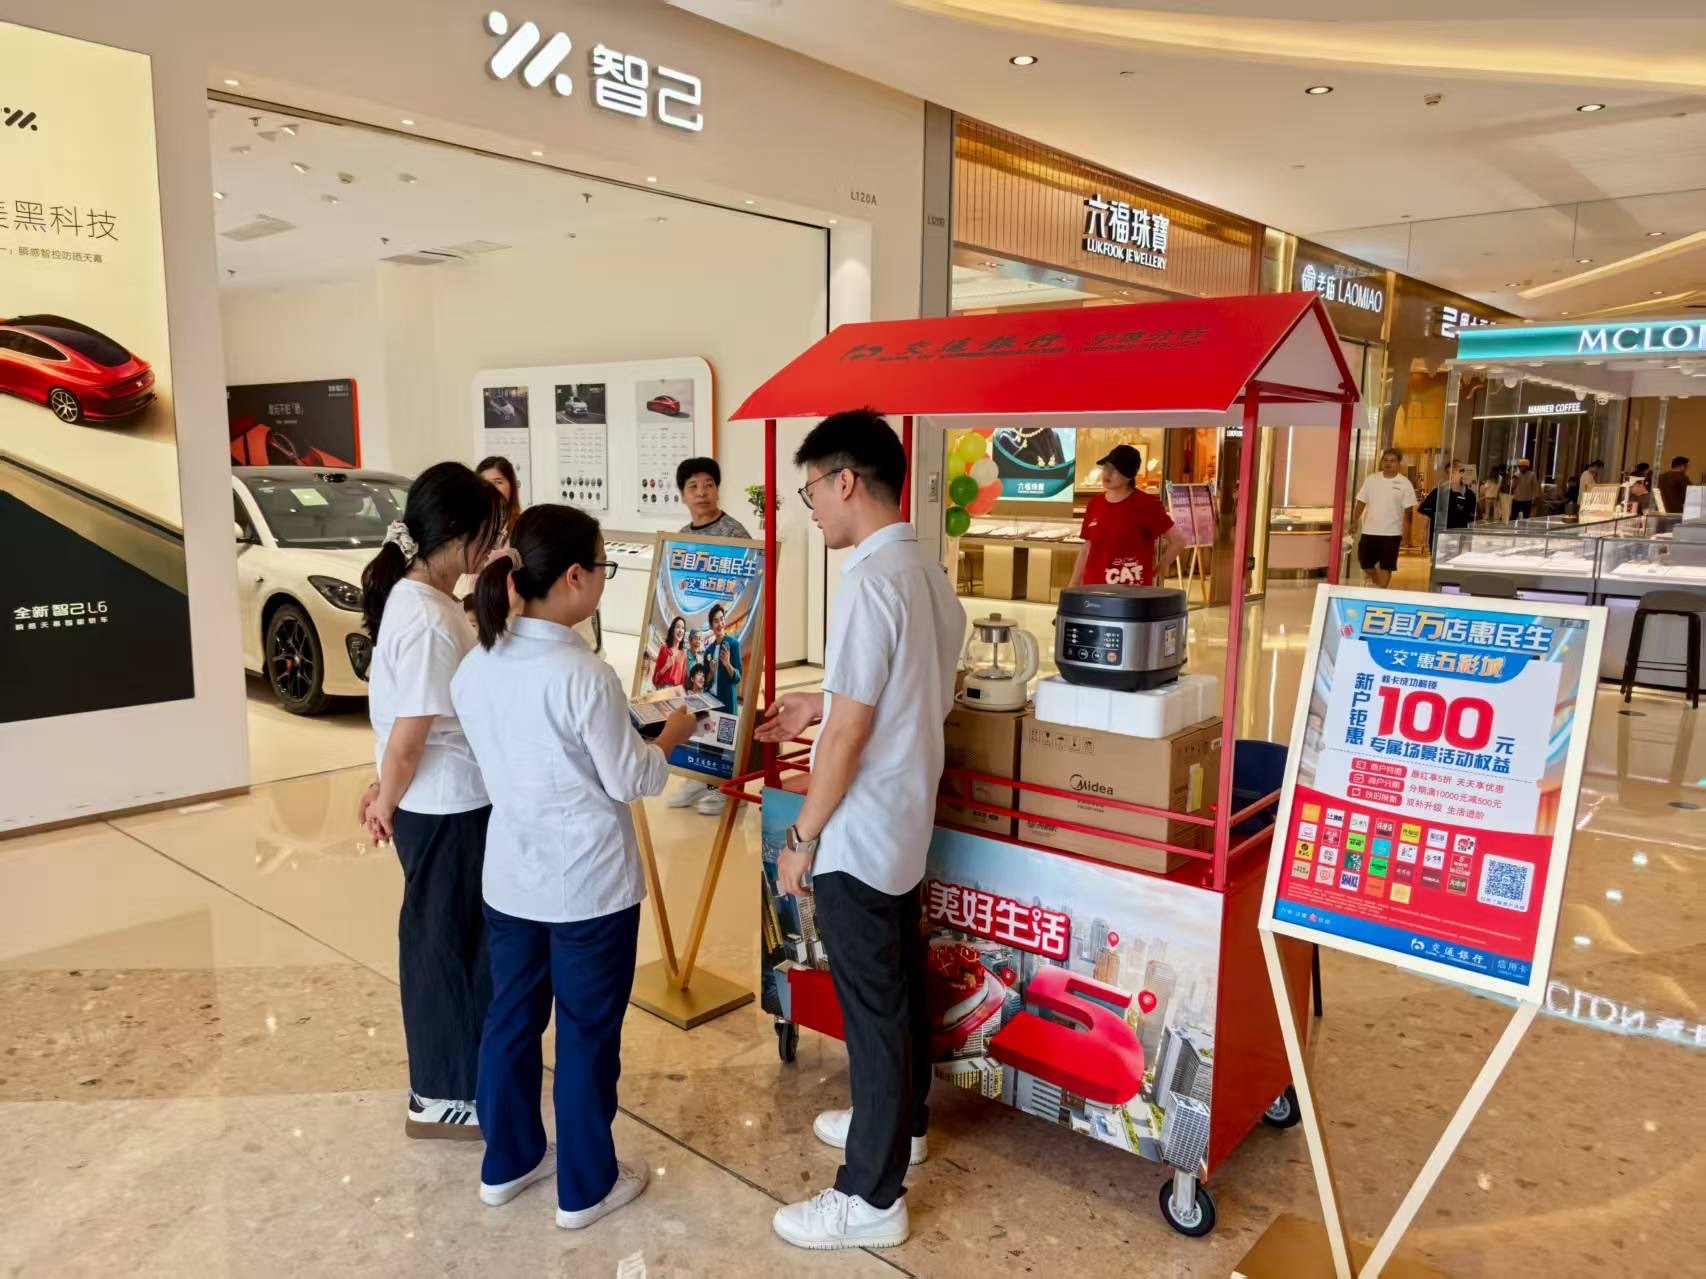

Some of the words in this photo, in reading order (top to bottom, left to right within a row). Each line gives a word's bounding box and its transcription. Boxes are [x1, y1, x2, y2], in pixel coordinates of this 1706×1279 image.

[593, 43, 704, 132] 智己
[850, 191, 878, 206] L120A
[1085, 193, 1169, 254] 六福珠寶
[1085, 238, 1126, 261] LUKFOOK
[1125, 248, 1168, 270] JEWELLERY
[1316, 272, 1337, 301] 老庙
[1338, 279, 1384, 313] LAOMIAO
[1577, 323, 1706, 353] MCLO
[1527, 404, 1554, 414] MANNER
[1555, 402, 1582, 412] COFFEE
[1362, 606, 1554, 651] 百县万店惠民生
[1344, 672, 1375, 746] 新户钜惠
[1377, 685, 1494, 750] 100
[1495, 735, 1516, 755] 元
[1370, 736, 1512, 774] 专属场景活动权益
[1071, 775, 1114, 795] Midea
[928, 881, 1066, 956] 美好生活
